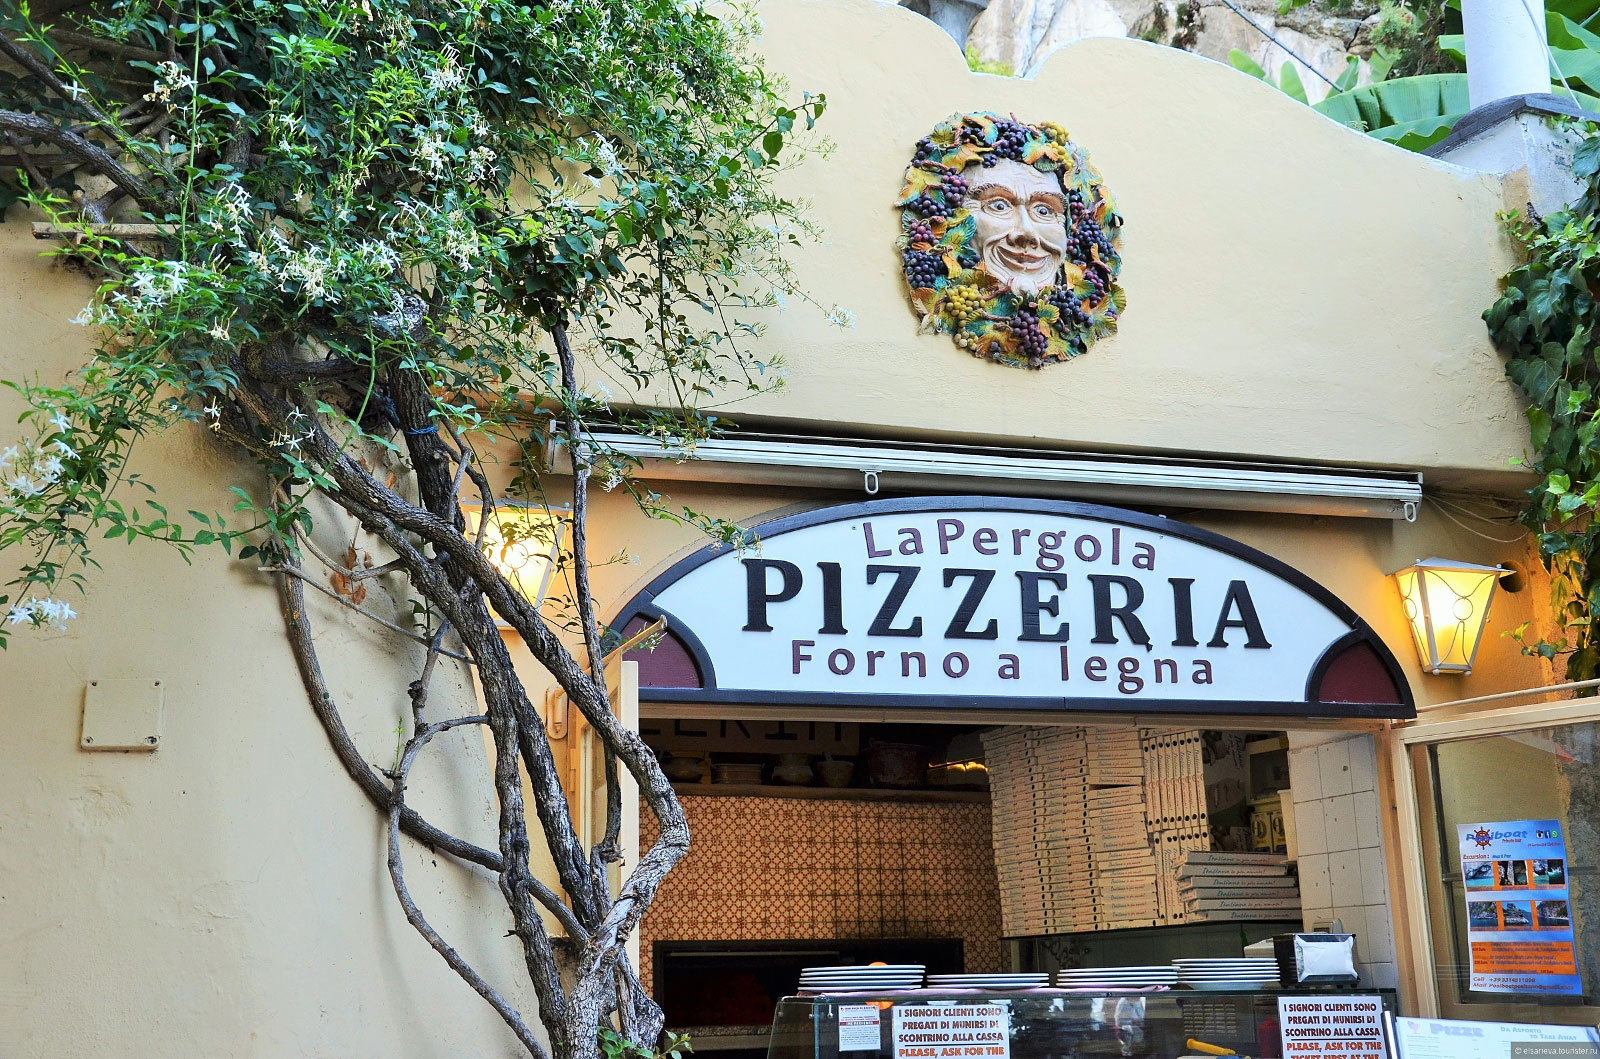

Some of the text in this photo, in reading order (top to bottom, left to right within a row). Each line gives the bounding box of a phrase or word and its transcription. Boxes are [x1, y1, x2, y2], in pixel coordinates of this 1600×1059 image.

[741, 558, 1273, 651] PIZZERIA
[792, 639, 1213, 694] Forno a legna
[977, 1008, 1001, 1016] SONO
[903, 1020, 998, 1029] PREGATI DI MUNIRSI DI
[899, 1033, 1003, 1042] SCONTRINO ALLA CASSA
[1287, 1042, 1322, 1052] PLEASE,
[899, 1048, 938, 1058] PLEASE,
[941, 1048, 962, 1056] ASK
[964, 1047, 983, 1055] FOR
